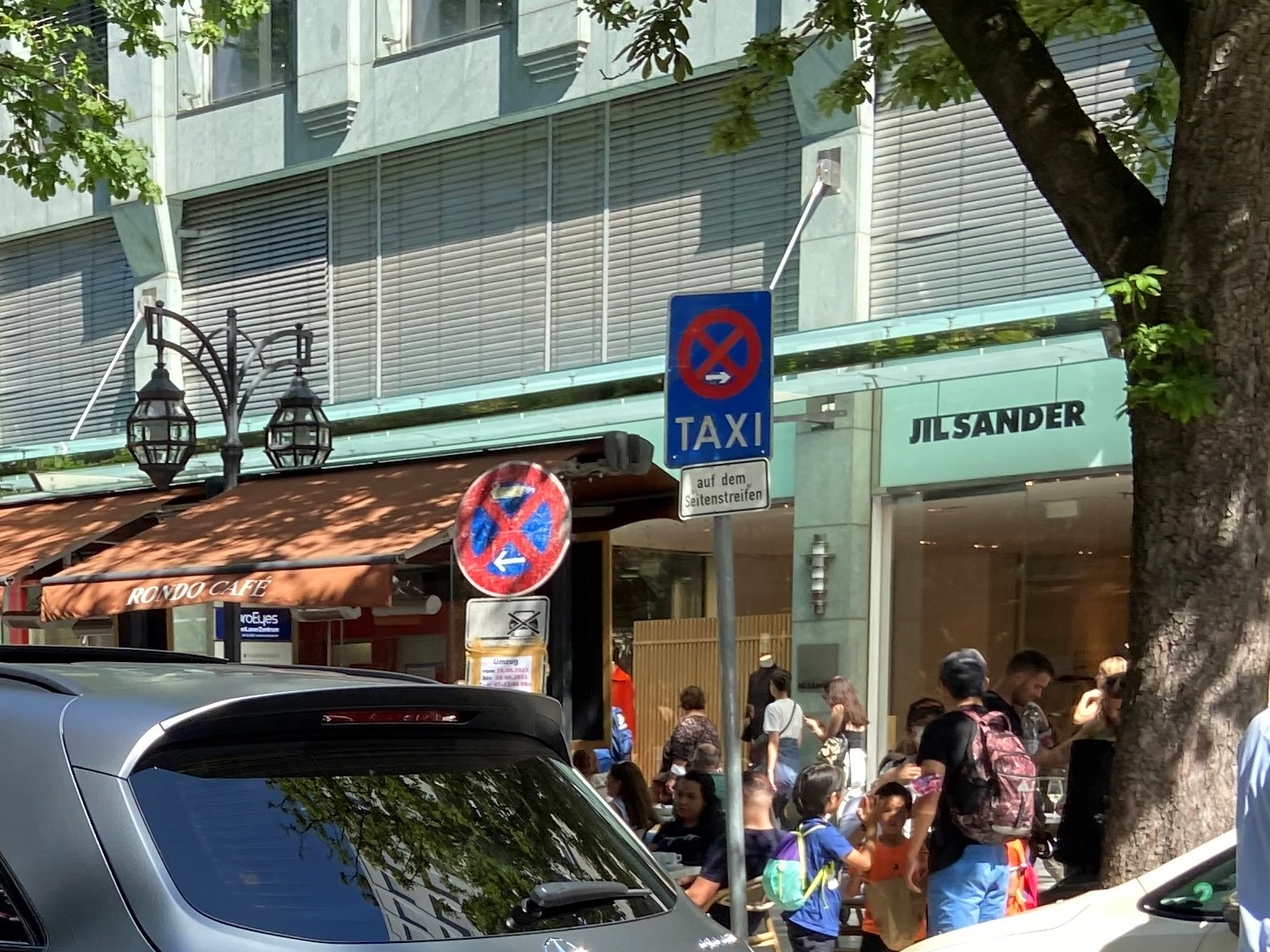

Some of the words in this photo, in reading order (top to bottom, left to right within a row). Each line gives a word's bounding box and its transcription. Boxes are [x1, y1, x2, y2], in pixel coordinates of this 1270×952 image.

[675, 412, 762, 451] TAXI
[909, 416, 949, 445] JIL
[952, 400, 1087, 439] SANDER
[697, 474, 716, 489] auf
[721, 472, 746, 487] dem
[685, 488, 763, 508] Seitenstreifen
[125, 581, 206, 606] RONDO
[208, 575, 273, 598] CAFÉ
